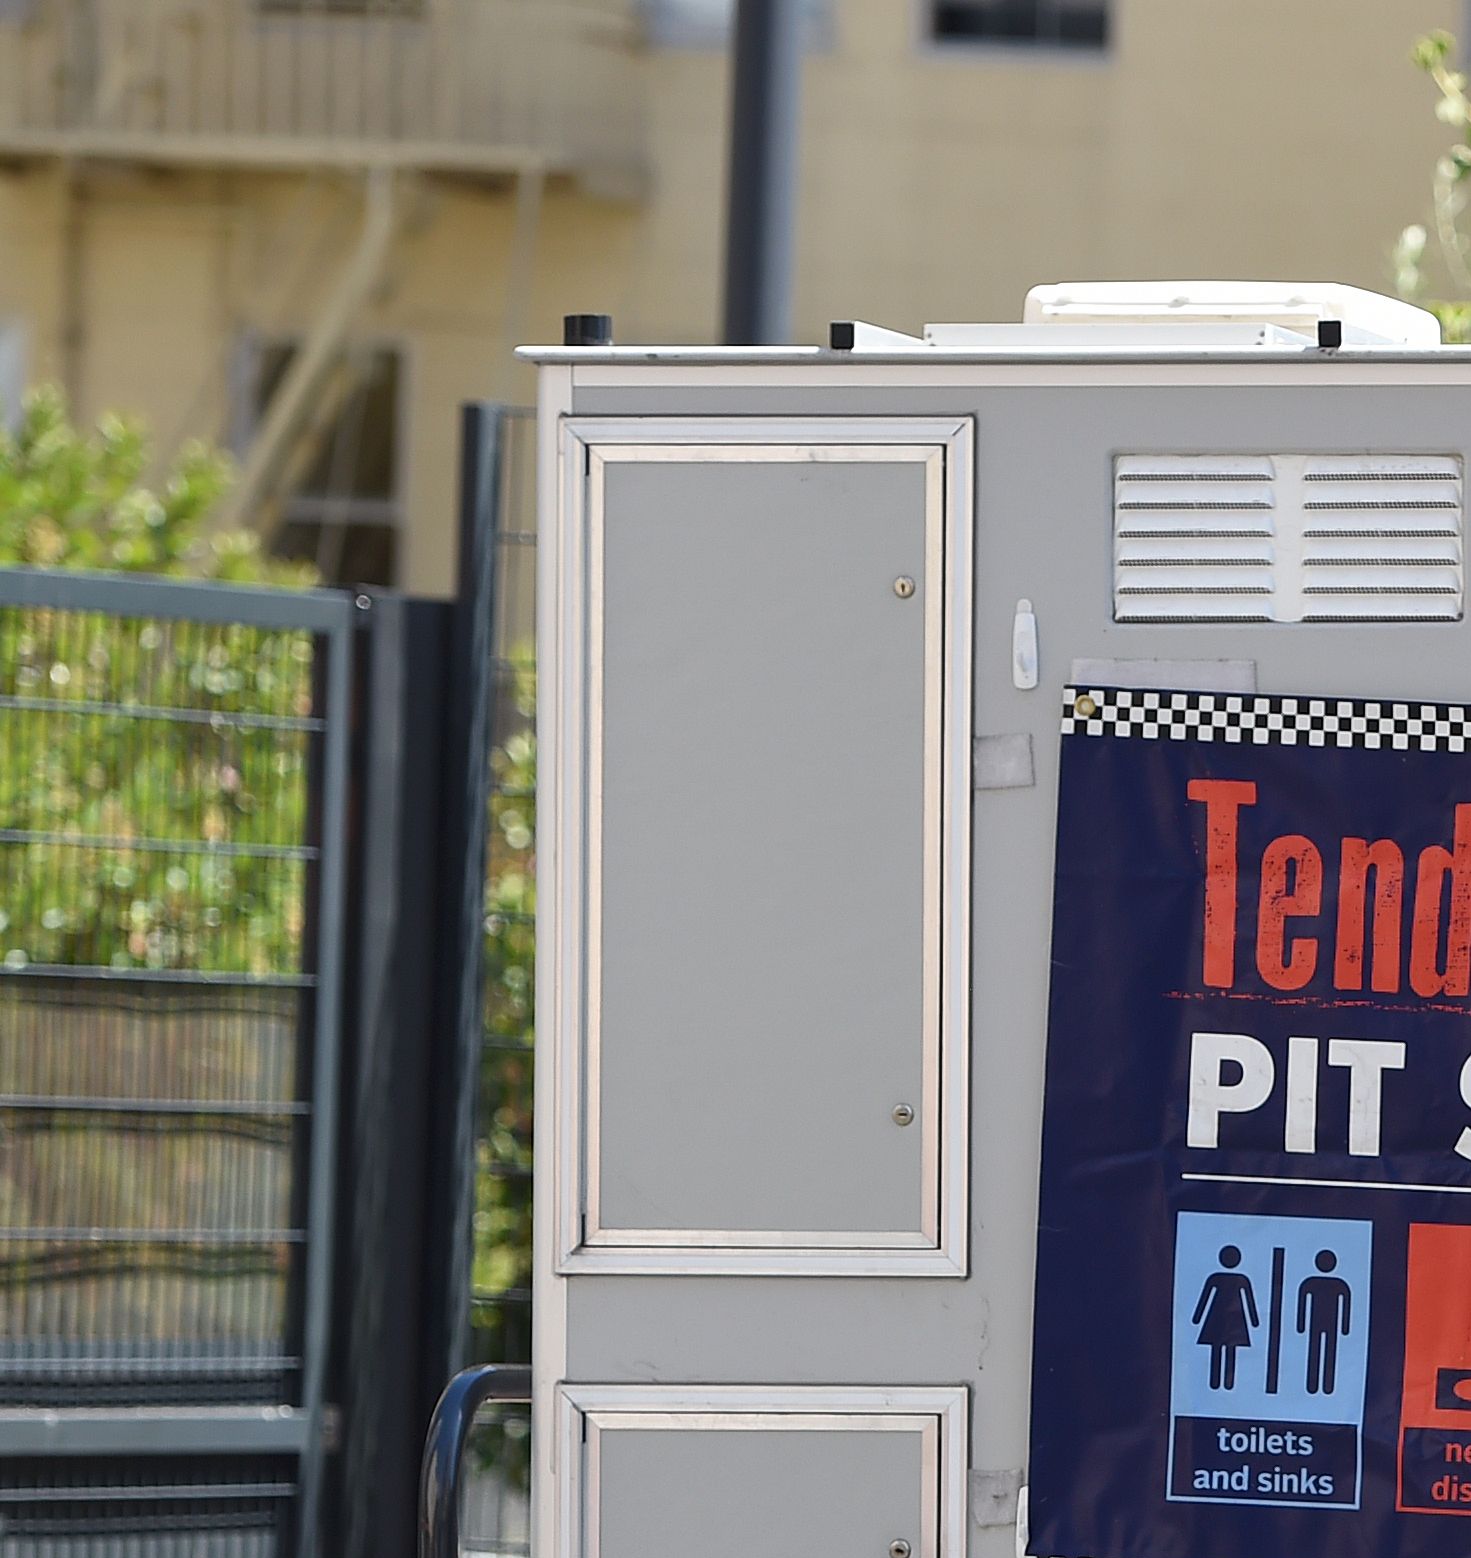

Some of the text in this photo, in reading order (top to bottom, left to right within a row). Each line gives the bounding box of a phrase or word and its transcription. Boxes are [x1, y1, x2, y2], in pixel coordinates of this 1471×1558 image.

[1186, 1032, 1407, 1157] PIT
[1216, 1426, 1314, 1456] toilets
[1193, 1465, 1334, 1495] and sinks
